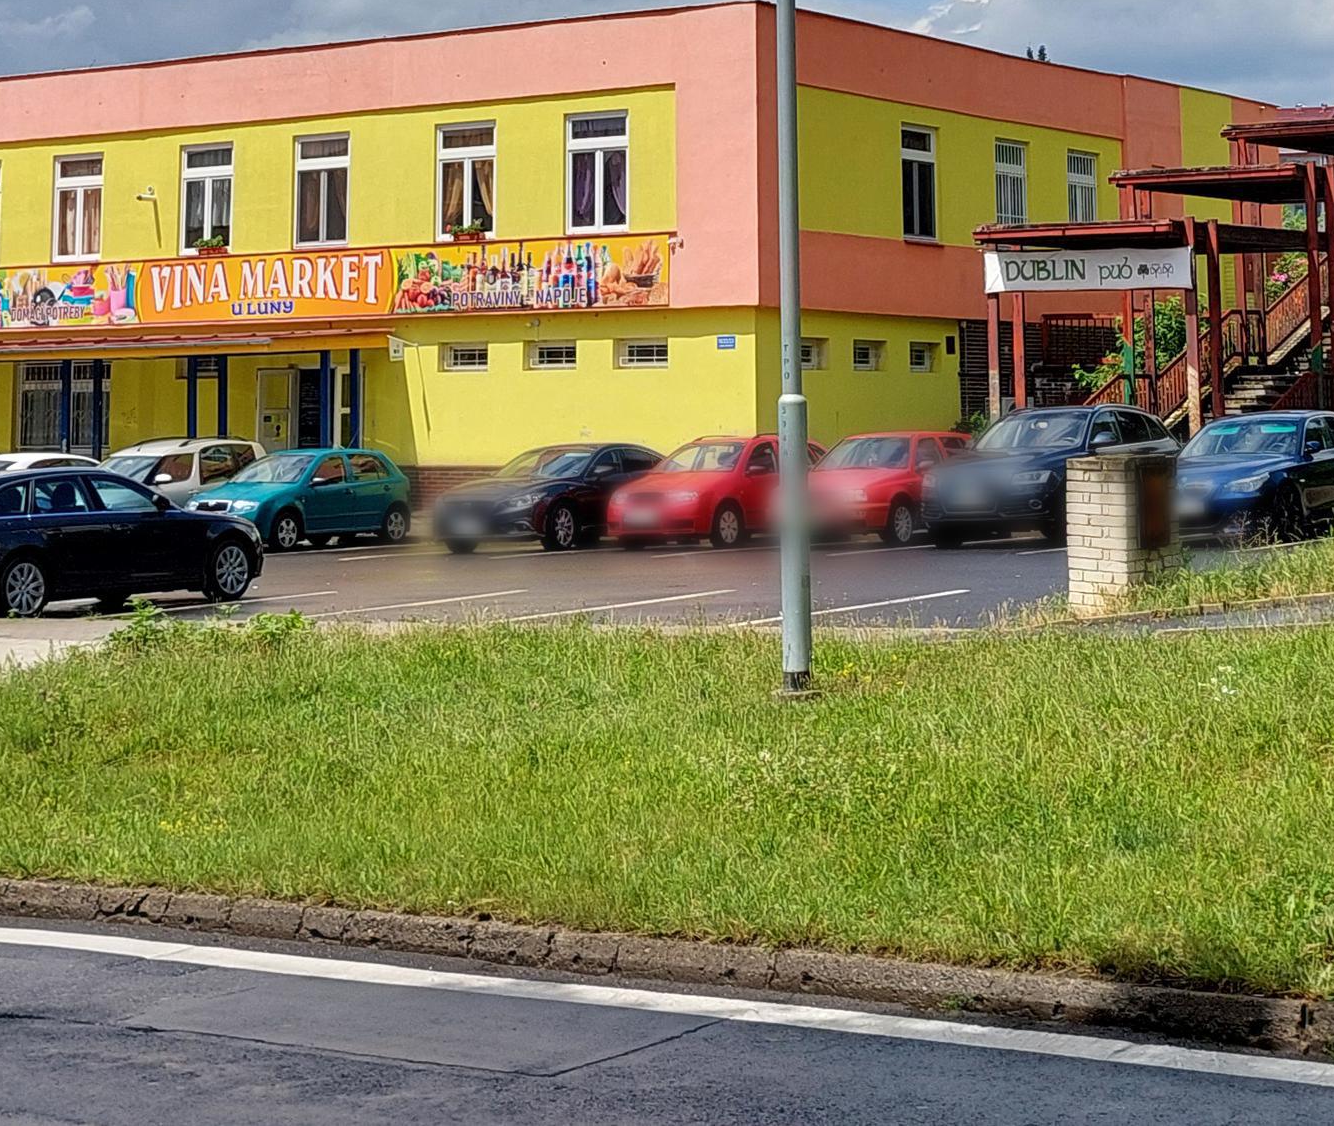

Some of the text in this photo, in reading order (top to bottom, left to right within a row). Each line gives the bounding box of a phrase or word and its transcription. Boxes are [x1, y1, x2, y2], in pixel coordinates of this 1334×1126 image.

[1004, 256, 1133, 285] DUBLIN pub
[150, 252, 384, 313] VINA MARKET
[231, 300, 294, 316] U LUNY
[452, 290, 521, 307] POTRAVINY
